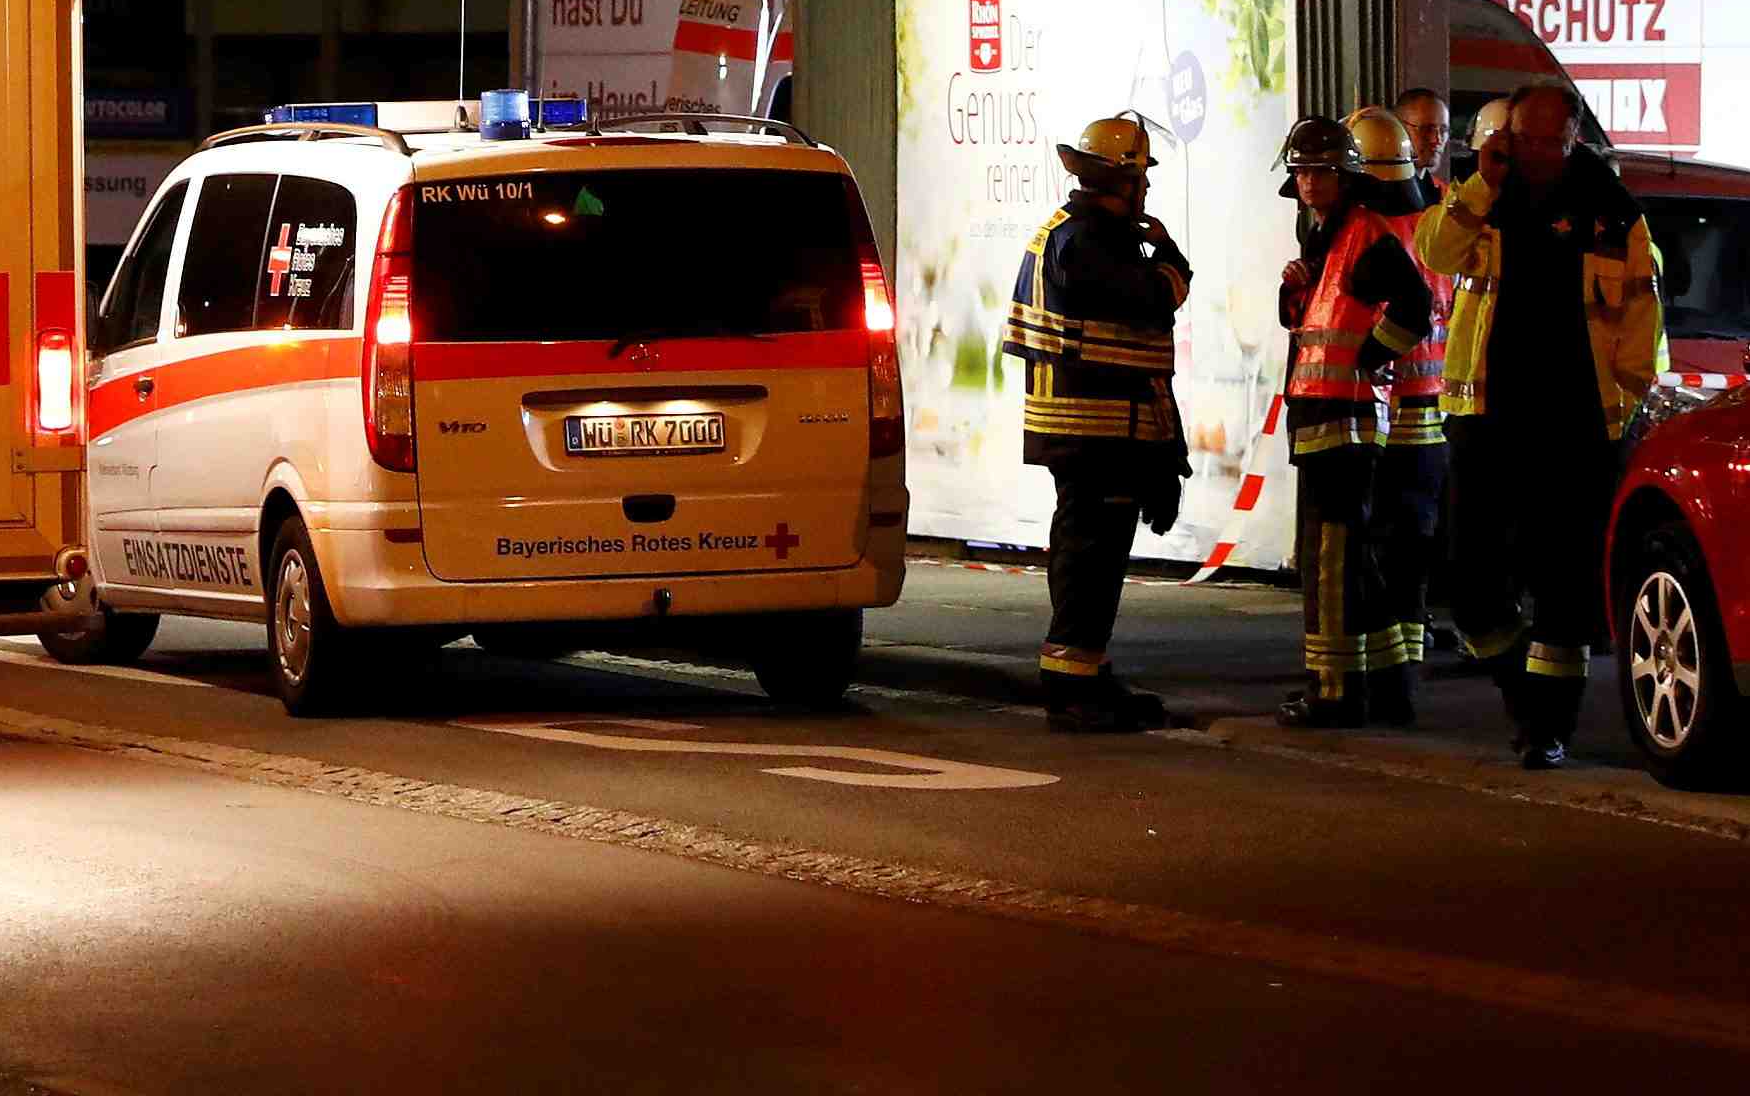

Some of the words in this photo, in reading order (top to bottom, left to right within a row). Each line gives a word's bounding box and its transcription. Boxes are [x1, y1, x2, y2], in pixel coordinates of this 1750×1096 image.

[948, 72, 1037, 144] Genuss
[421, 185, 452, 202] RK
[457, 183, 489, 201] Wü
[495, 183, 534, 201] 10/1
[986, 155, 1037, 203] reiner
[631, 420, 658, 446] RK
[665, 418, 719, 445] 7000
[123, 538, 253, 587] EINSATZDIENSTE
[497, 536, 624, 559] Bayerisches
[632, 534, 691, 554] Rotes
[698, 532, 758, 553] Kreuz
